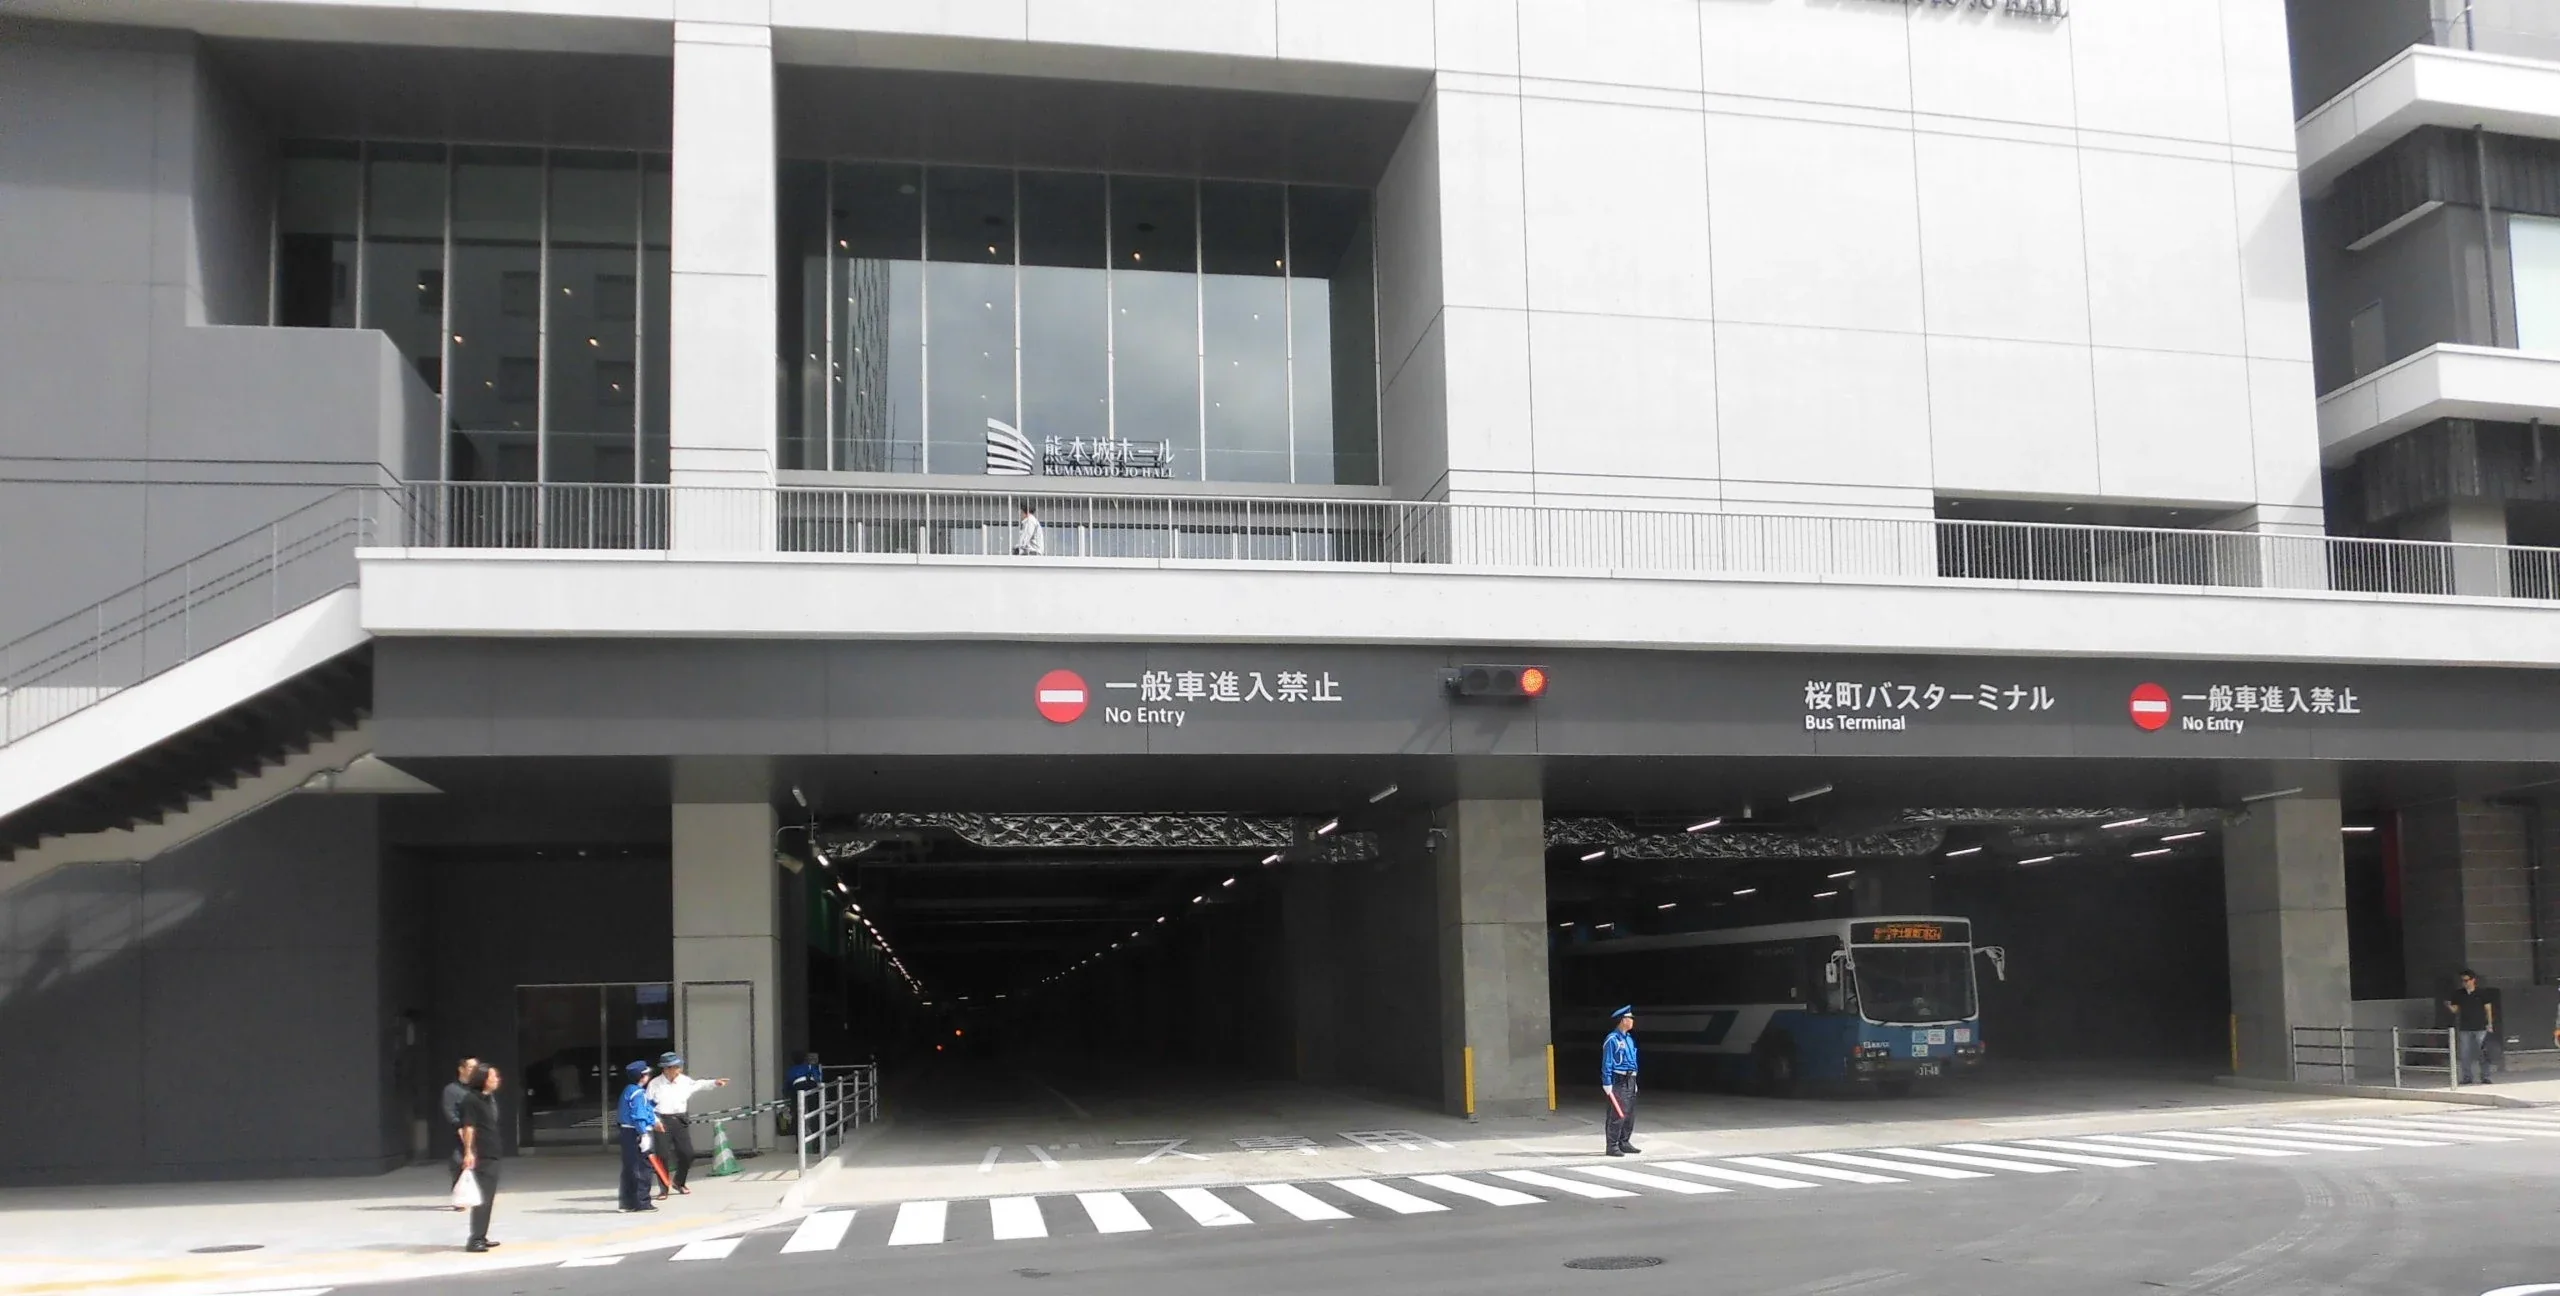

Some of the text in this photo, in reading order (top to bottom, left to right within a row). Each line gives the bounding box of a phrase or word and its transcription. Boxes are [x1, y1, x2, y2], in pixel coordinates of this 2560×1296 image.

[1044, 435, 1175, 464] 熊本城ホール
[1142, 467, 1175, 478] HALL
[1105, 670, 1343, 702] 一般車進入禁止
[1804, 680, 2055, 711] 桜町バスターミナル
[2181, 684, 2361, 714] 一般車進入禁止
[1105, 706, 1186, 727] No Entry
[1805, 714, 1906, 730] Bus Terminal
[2182, 716, 2244, 734] No Entry
